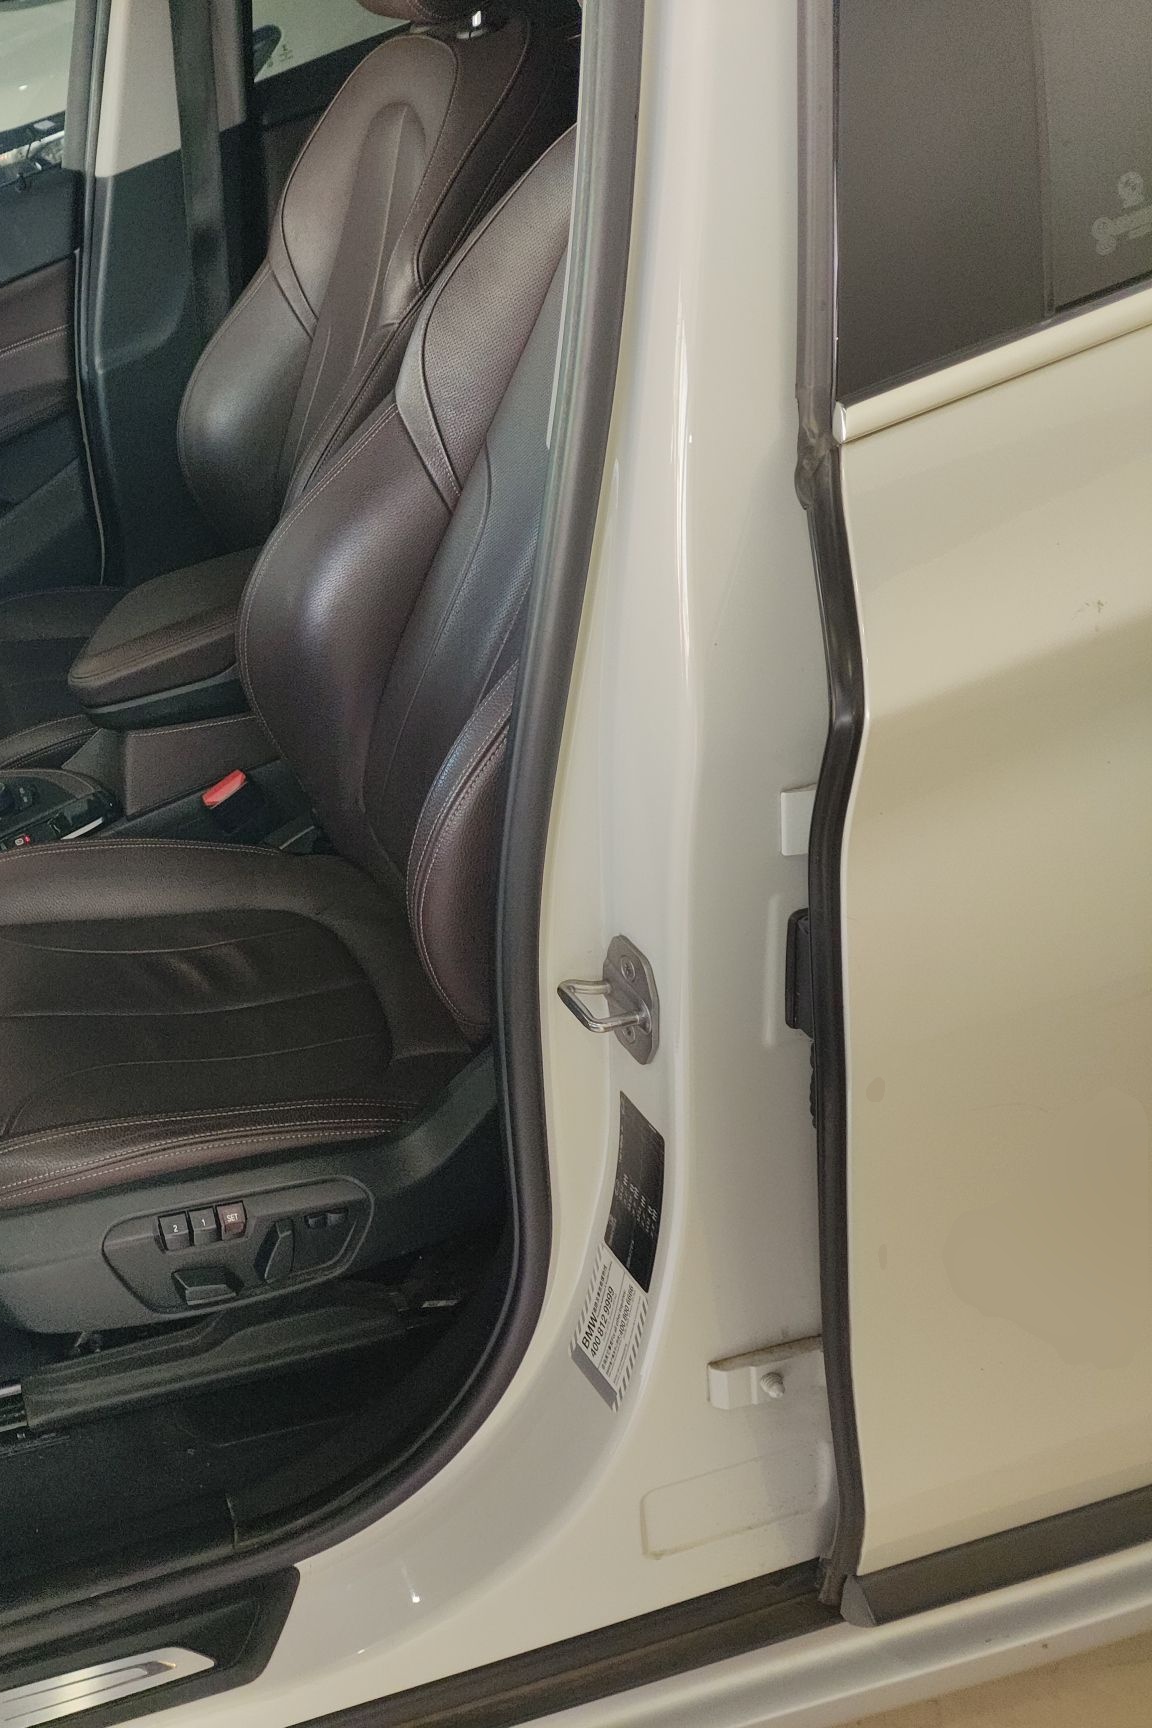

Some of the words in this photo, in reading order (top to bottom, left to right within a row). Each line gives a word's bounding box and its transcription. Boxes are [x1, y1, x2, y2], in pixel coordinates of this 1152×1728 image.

[226, 1213, 238, 1222] SET
[582, 1311, 598, 1350] BMW
[590, 1335, 601, 1358] 400
[597, 1313, 607, 1337] 812
[603, 1285, 615, 1315] 9999
